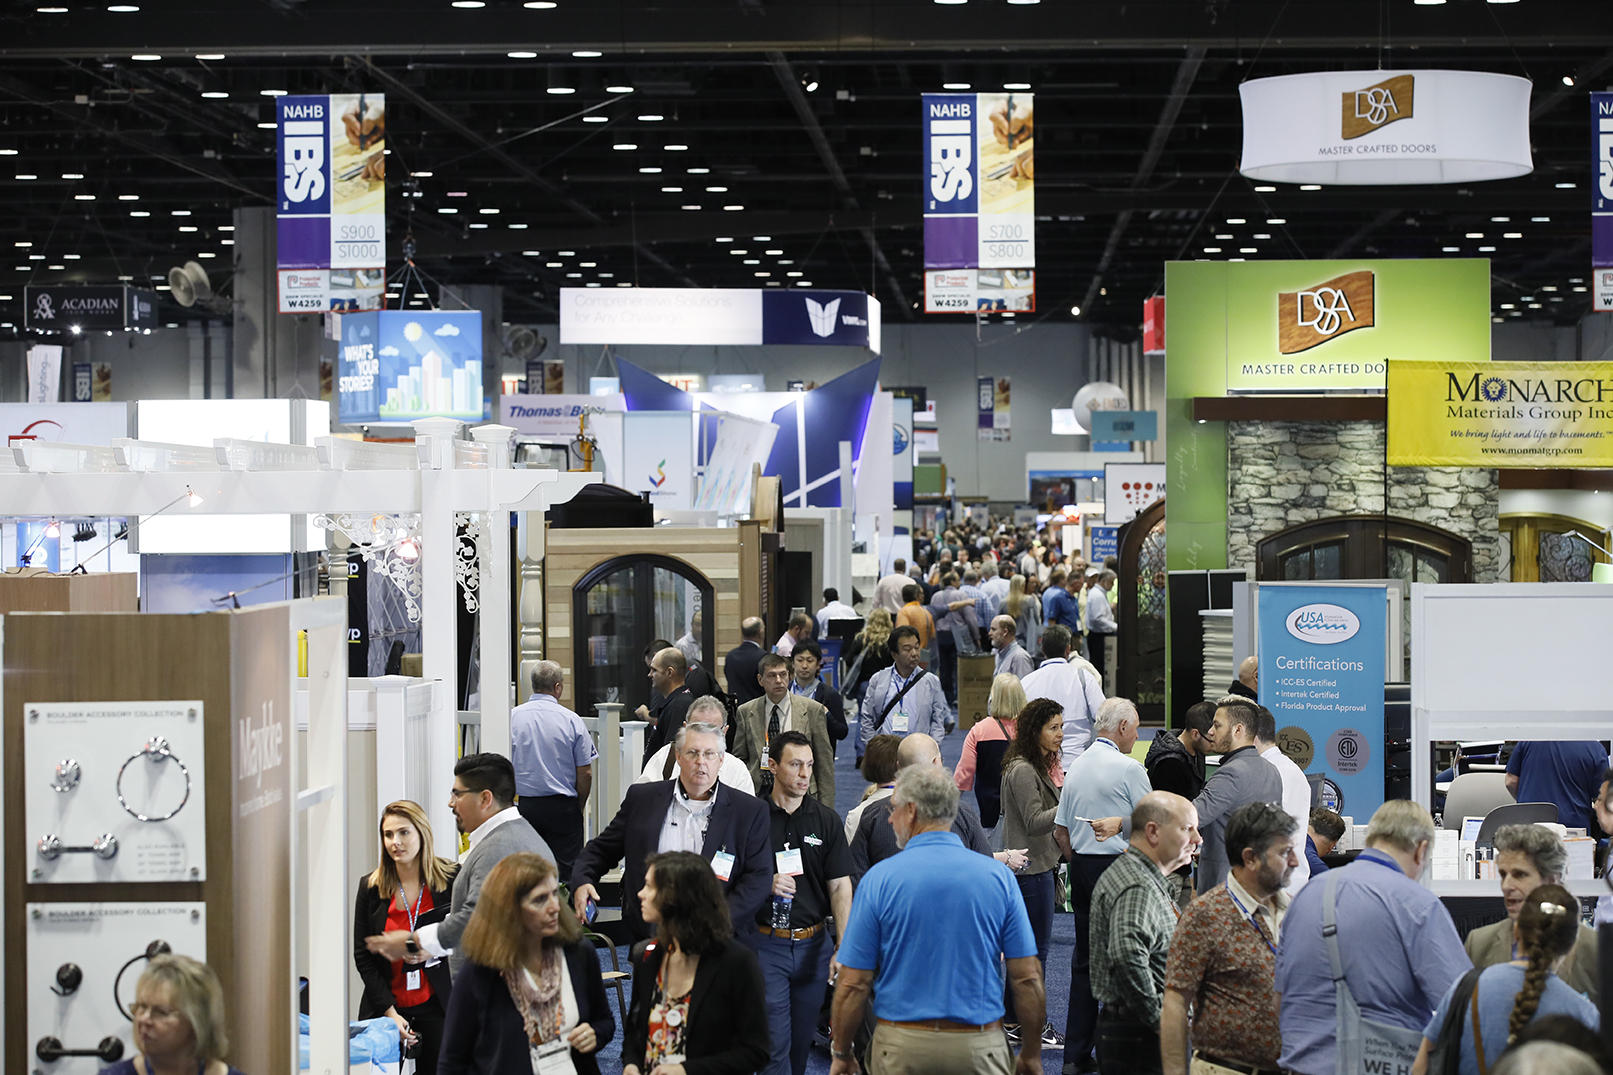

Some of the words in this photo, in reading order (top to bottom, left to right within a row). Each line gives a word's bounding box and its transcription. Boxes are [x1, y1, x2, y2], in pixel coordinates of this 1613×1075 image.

[283, 105, 324, 118] NAHB
[930, 104, 971, 117] NAHB
[1318, 146, 1353, 155] MASTER
[1356, 144, 1398, 154] CRAFTED
[1401, 144, 1437, 153] DOORS
[283, 121, 326, 203] IBS
[930, 120, 973, 203] IBS
[341, 225, 375, 239] S900
[989, 225, 1022, 239] S700
[338, 244, 378, 258] S1000
[989, 244, 1024, 258] S800
[61, 298, 119, 310] ACADIAN
[288, 300, 322, 308] W4259
[574, 293, 671, 309] Comprehensive
[675, 294, 732, 308] Solutions
[574, 311, 590, 323] for
[593, 311, 617, 325] Any
[357, 359, 379, 375] YOUR
[1242, 364, 1295, 375] MASTER
[1300, 363, 1360, 374] CRAFTED
[339, 375, 374, 393] STORIES?
[1447, 405, 1524, 419] Materials
[1529, 406, 1583, 422] Group
[1450, 430, 1464, 439] We
[1465, 429, 1489, 442] bring
[1491, 429, 1512, 442] light
[1514, 429, 1532, 439] and
[1533, 429, 1548, 443] life
[1549, 430, 1558, 438] to
[1481, 447, 1583, 456] www.monmatgrp.com
[1301, 612, 1324, 623] USA
[1276, 655, 1364, 671] Certifications
[1281, 678, 1305, 686] ICC-ES
[1306, 678, 1337, 687] Certified
[1281, 690, 1308, 698] Intertek
[1309, 690, 1340, 699] Certified
[1281, 701, 1305, 710] Florida
[1306, 702, 1333, 711] Product
[1334, 703, 1367, 713] Approval
[1286, 740, 1303, 753] ES
[1363, 1059, 1391, 1075] WE
